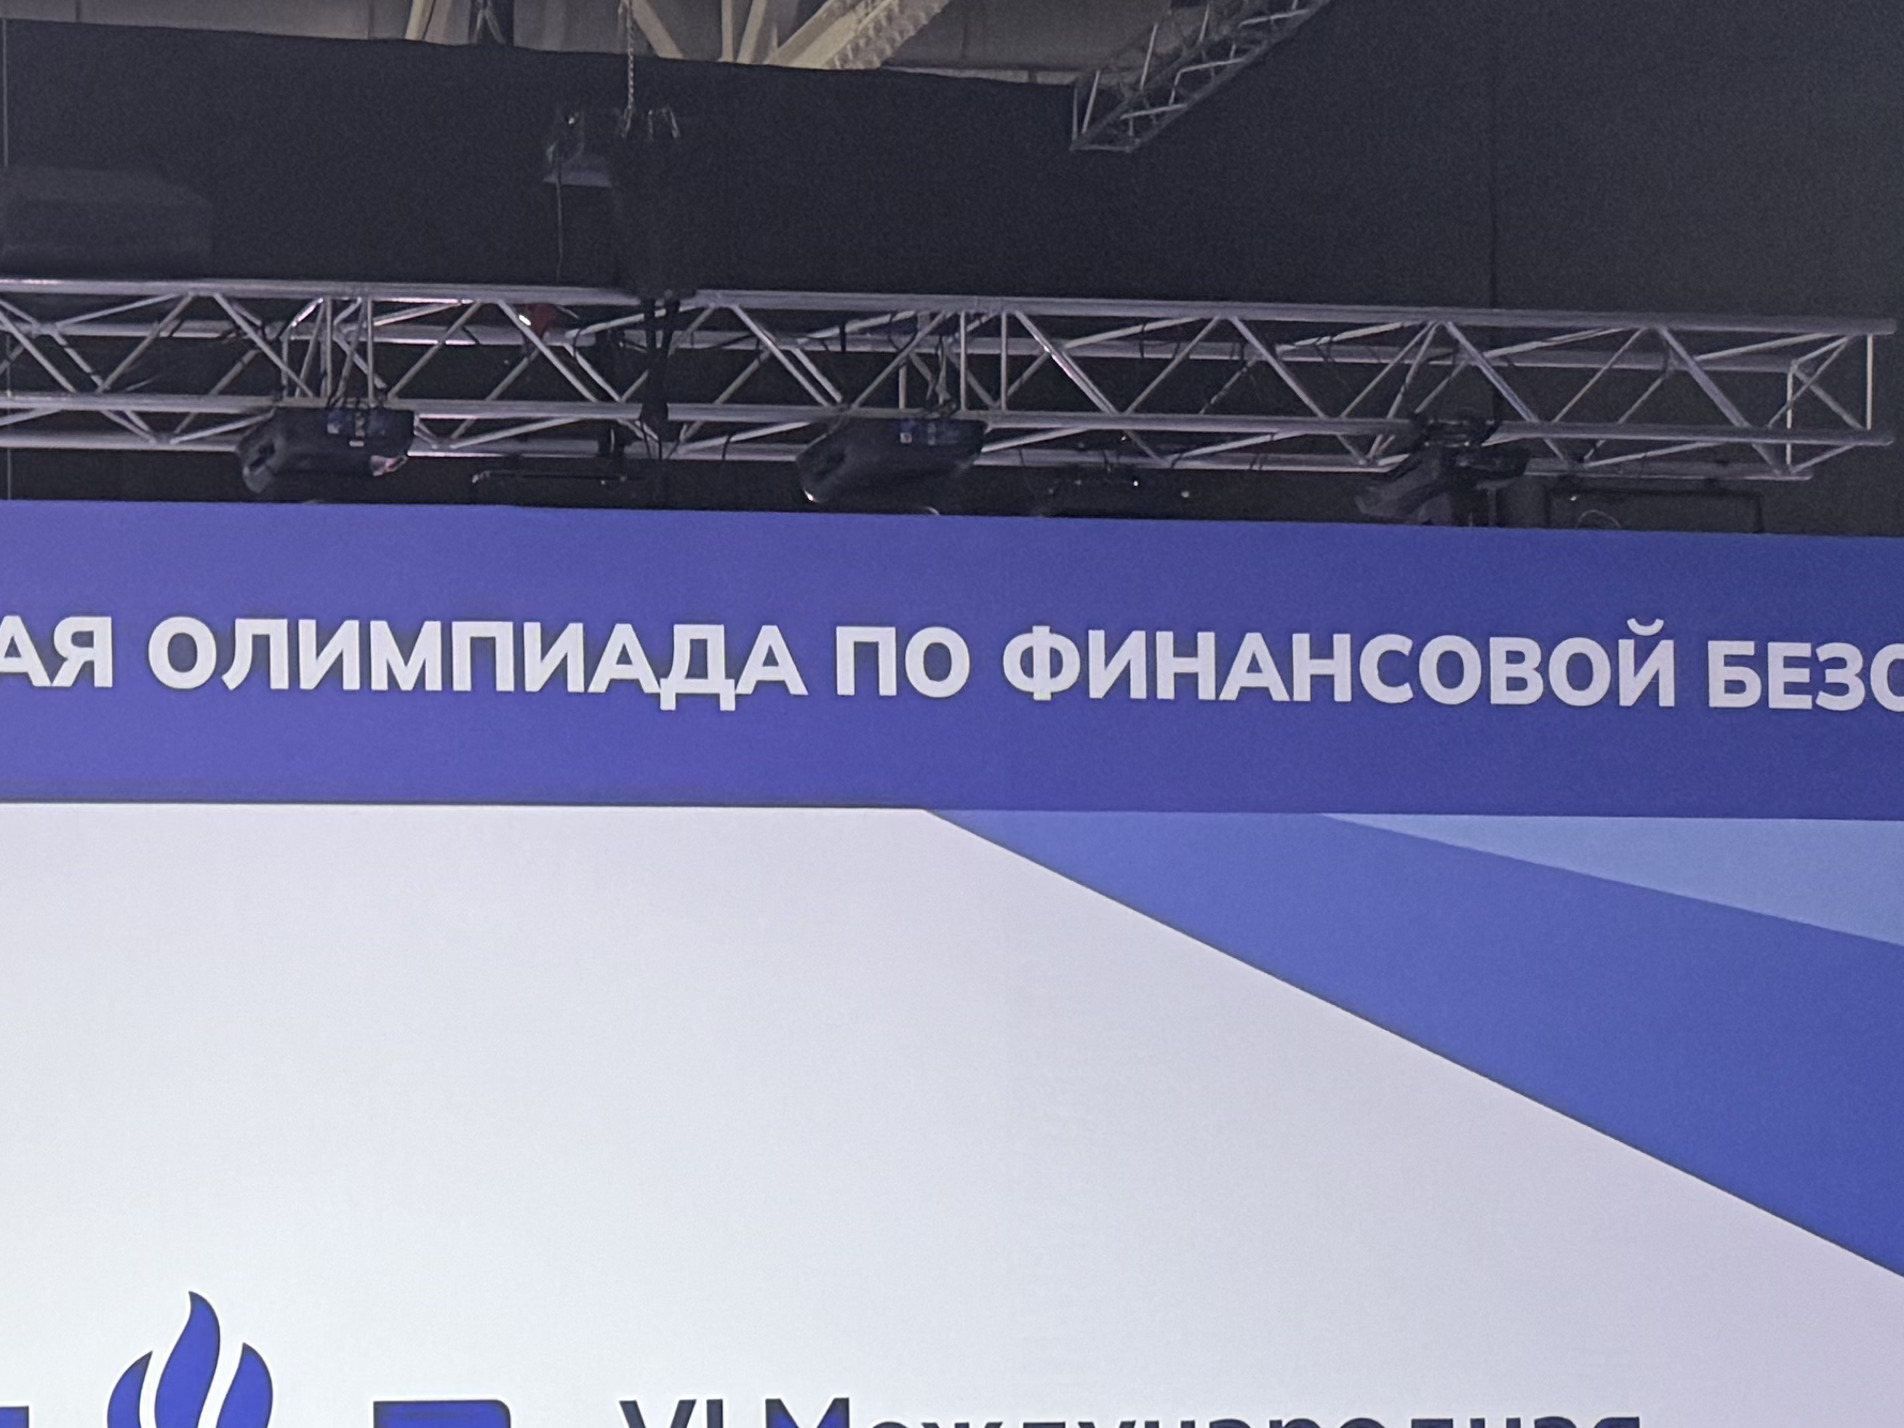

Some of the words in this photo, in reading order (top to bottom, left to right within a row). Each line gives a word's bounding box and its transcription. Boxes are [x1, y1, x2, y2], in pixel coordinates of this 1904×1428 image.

[147, 615, 809, 712] ОЛИМПИАДА
[835, 625, 972, 699] ПО
[1002, 616, 1676, 708] ФИНАНСОВОЙ
